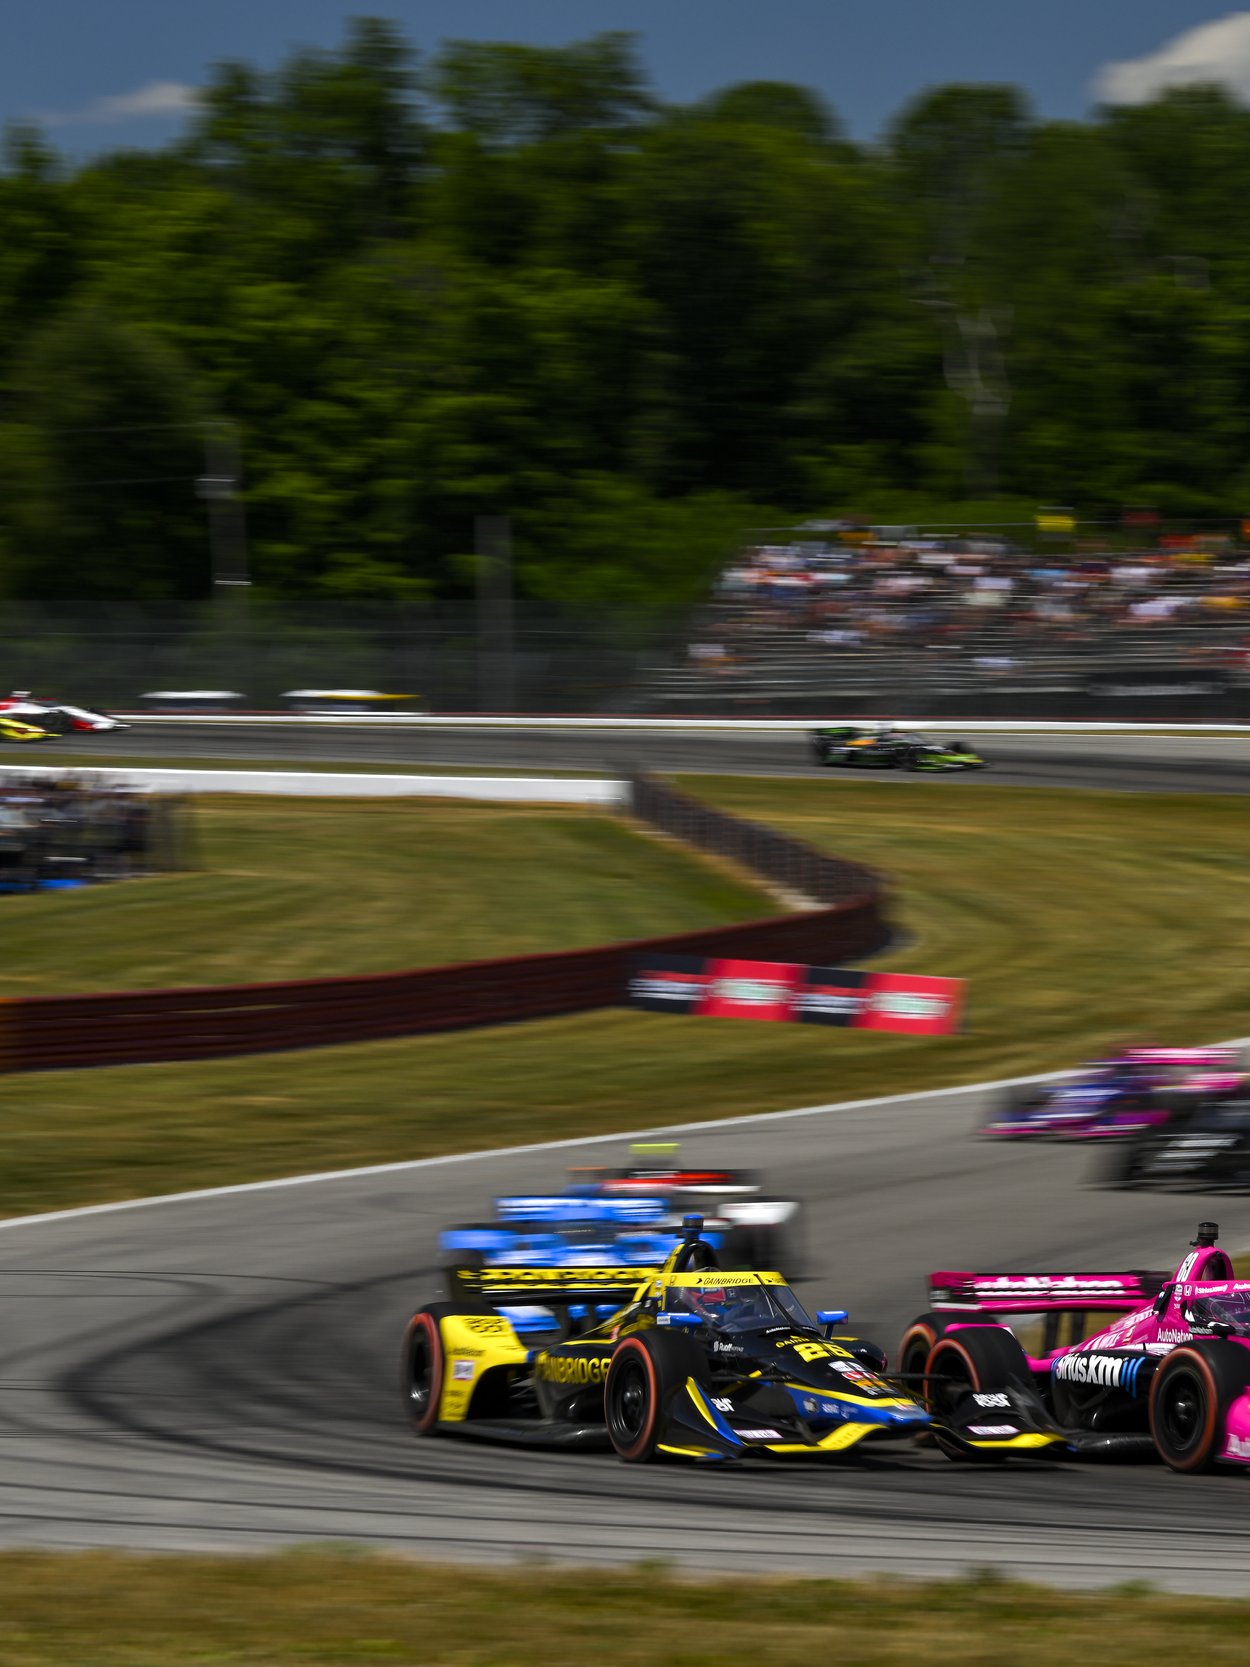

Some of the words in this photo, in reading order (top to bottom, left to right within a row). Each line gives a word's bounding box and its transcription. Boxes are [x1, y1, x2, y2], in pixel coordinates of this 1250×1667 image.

[703, 1277, 754, 1286] GAINBRIDGE
[1157, 1327, 1193, 1343] AutoNation
[793, 1342, 855, 1363] 26
